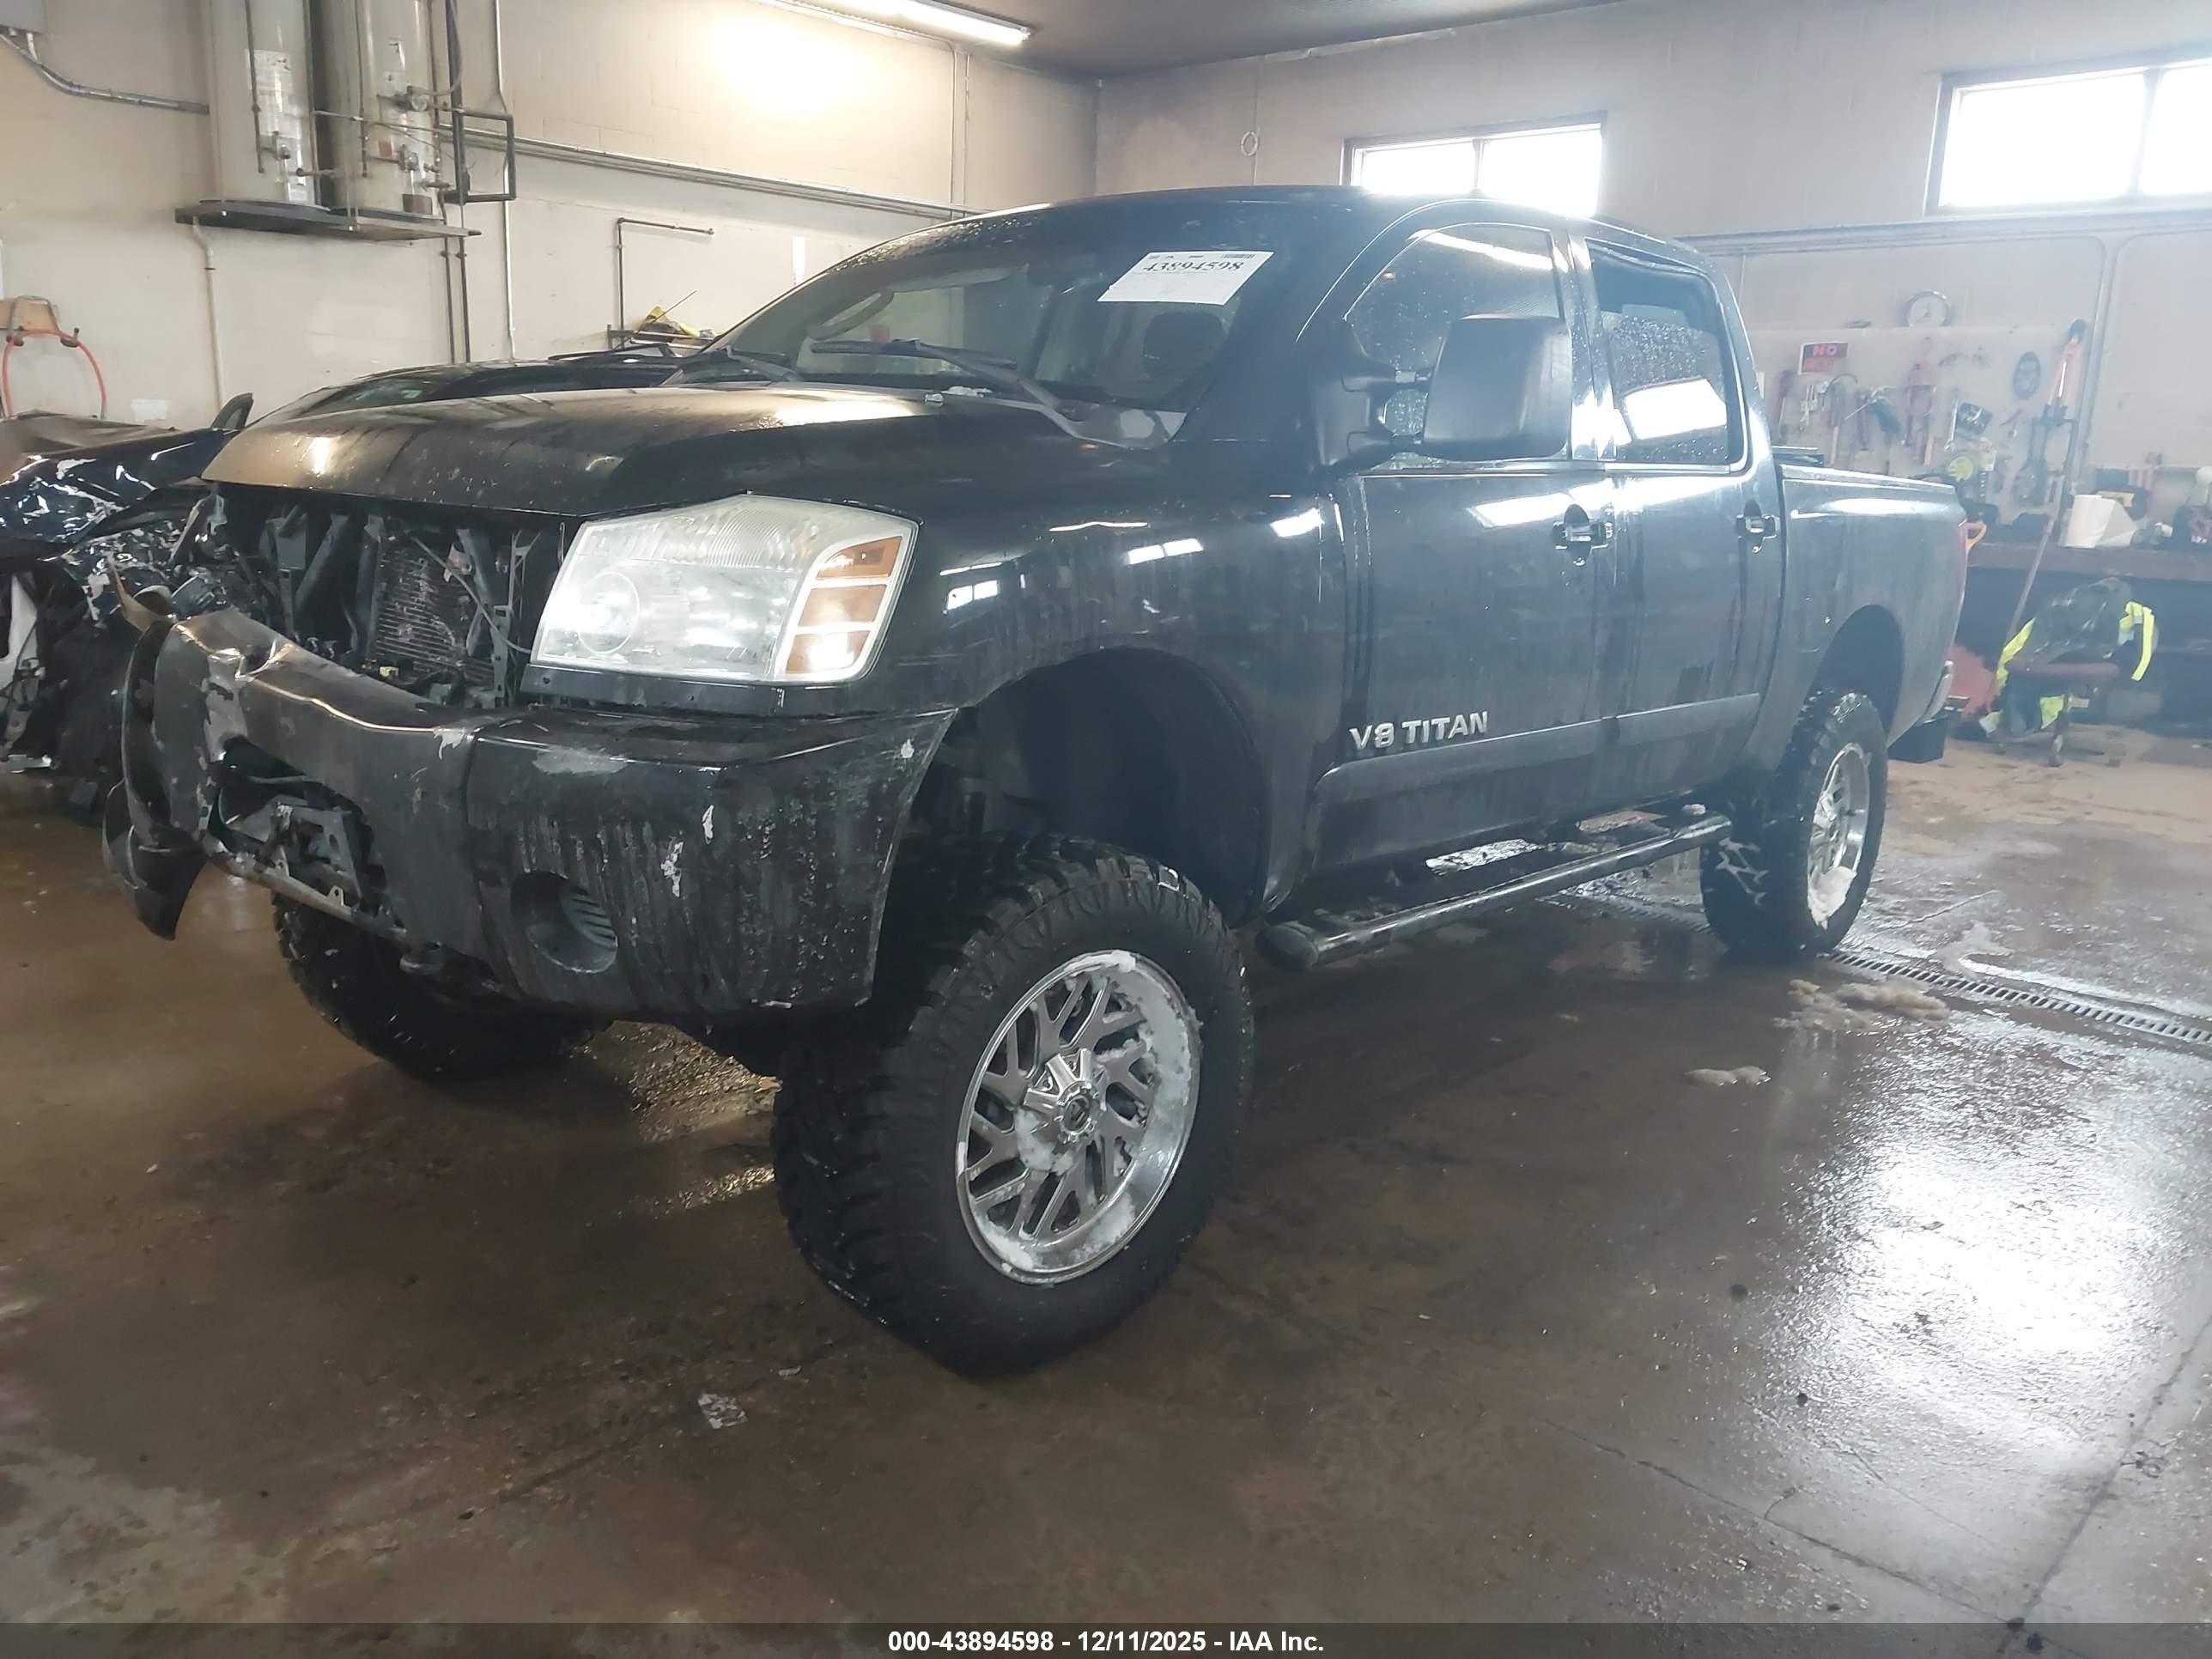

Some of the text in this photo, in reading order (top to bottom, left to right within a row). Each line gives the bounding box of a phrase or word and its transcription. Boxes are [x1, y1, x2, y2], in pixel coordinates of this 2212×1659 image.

[1143, 261, 1244, 271] 43894598
[1349, 711, 1488, 750] V8 TITAN
